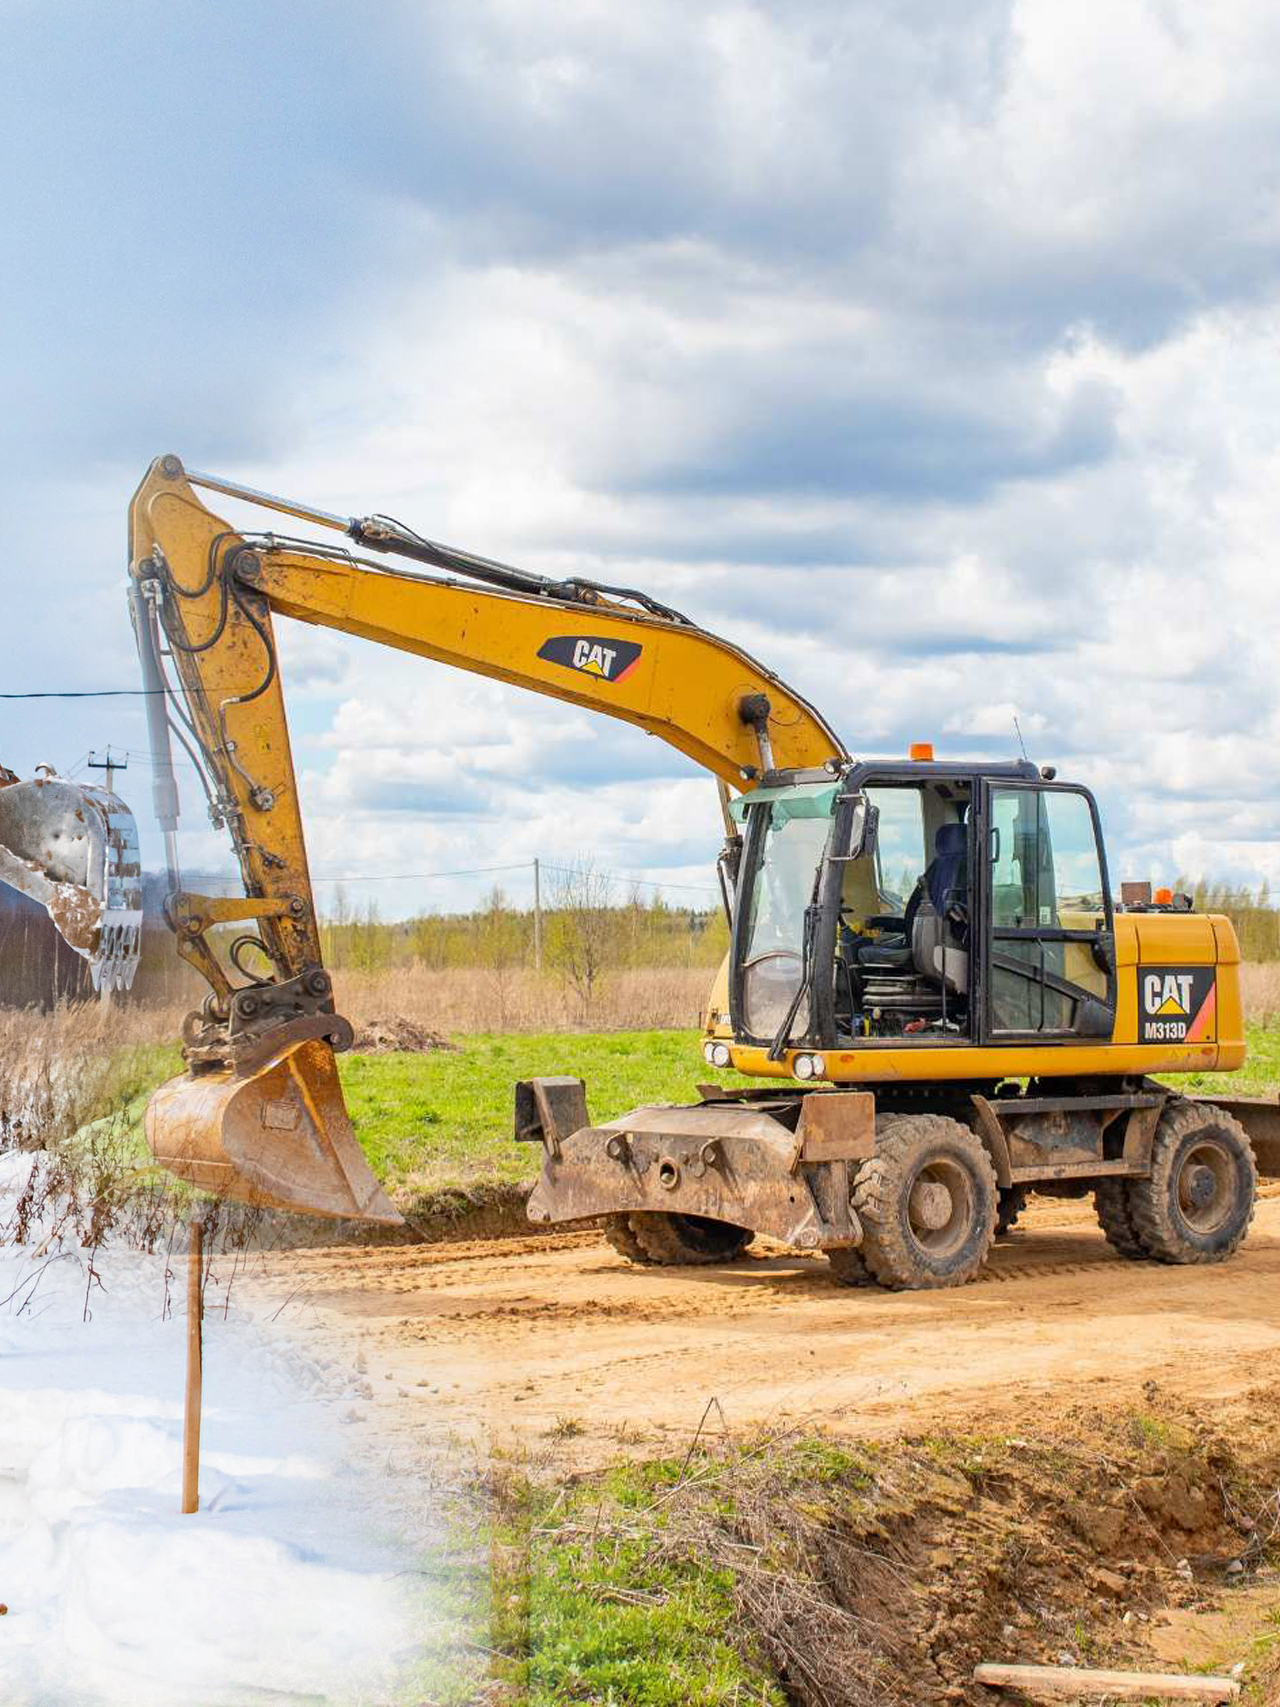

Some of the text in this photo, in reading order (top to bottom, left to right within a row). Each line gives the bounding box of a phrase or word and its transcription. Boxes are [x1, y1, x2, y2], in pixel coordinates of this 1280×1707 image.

[572, 640, 616, 677] CAT
[1144, 974, 1194, 1015] CAT
[1144, 1022, 1187, 1039] M313D
